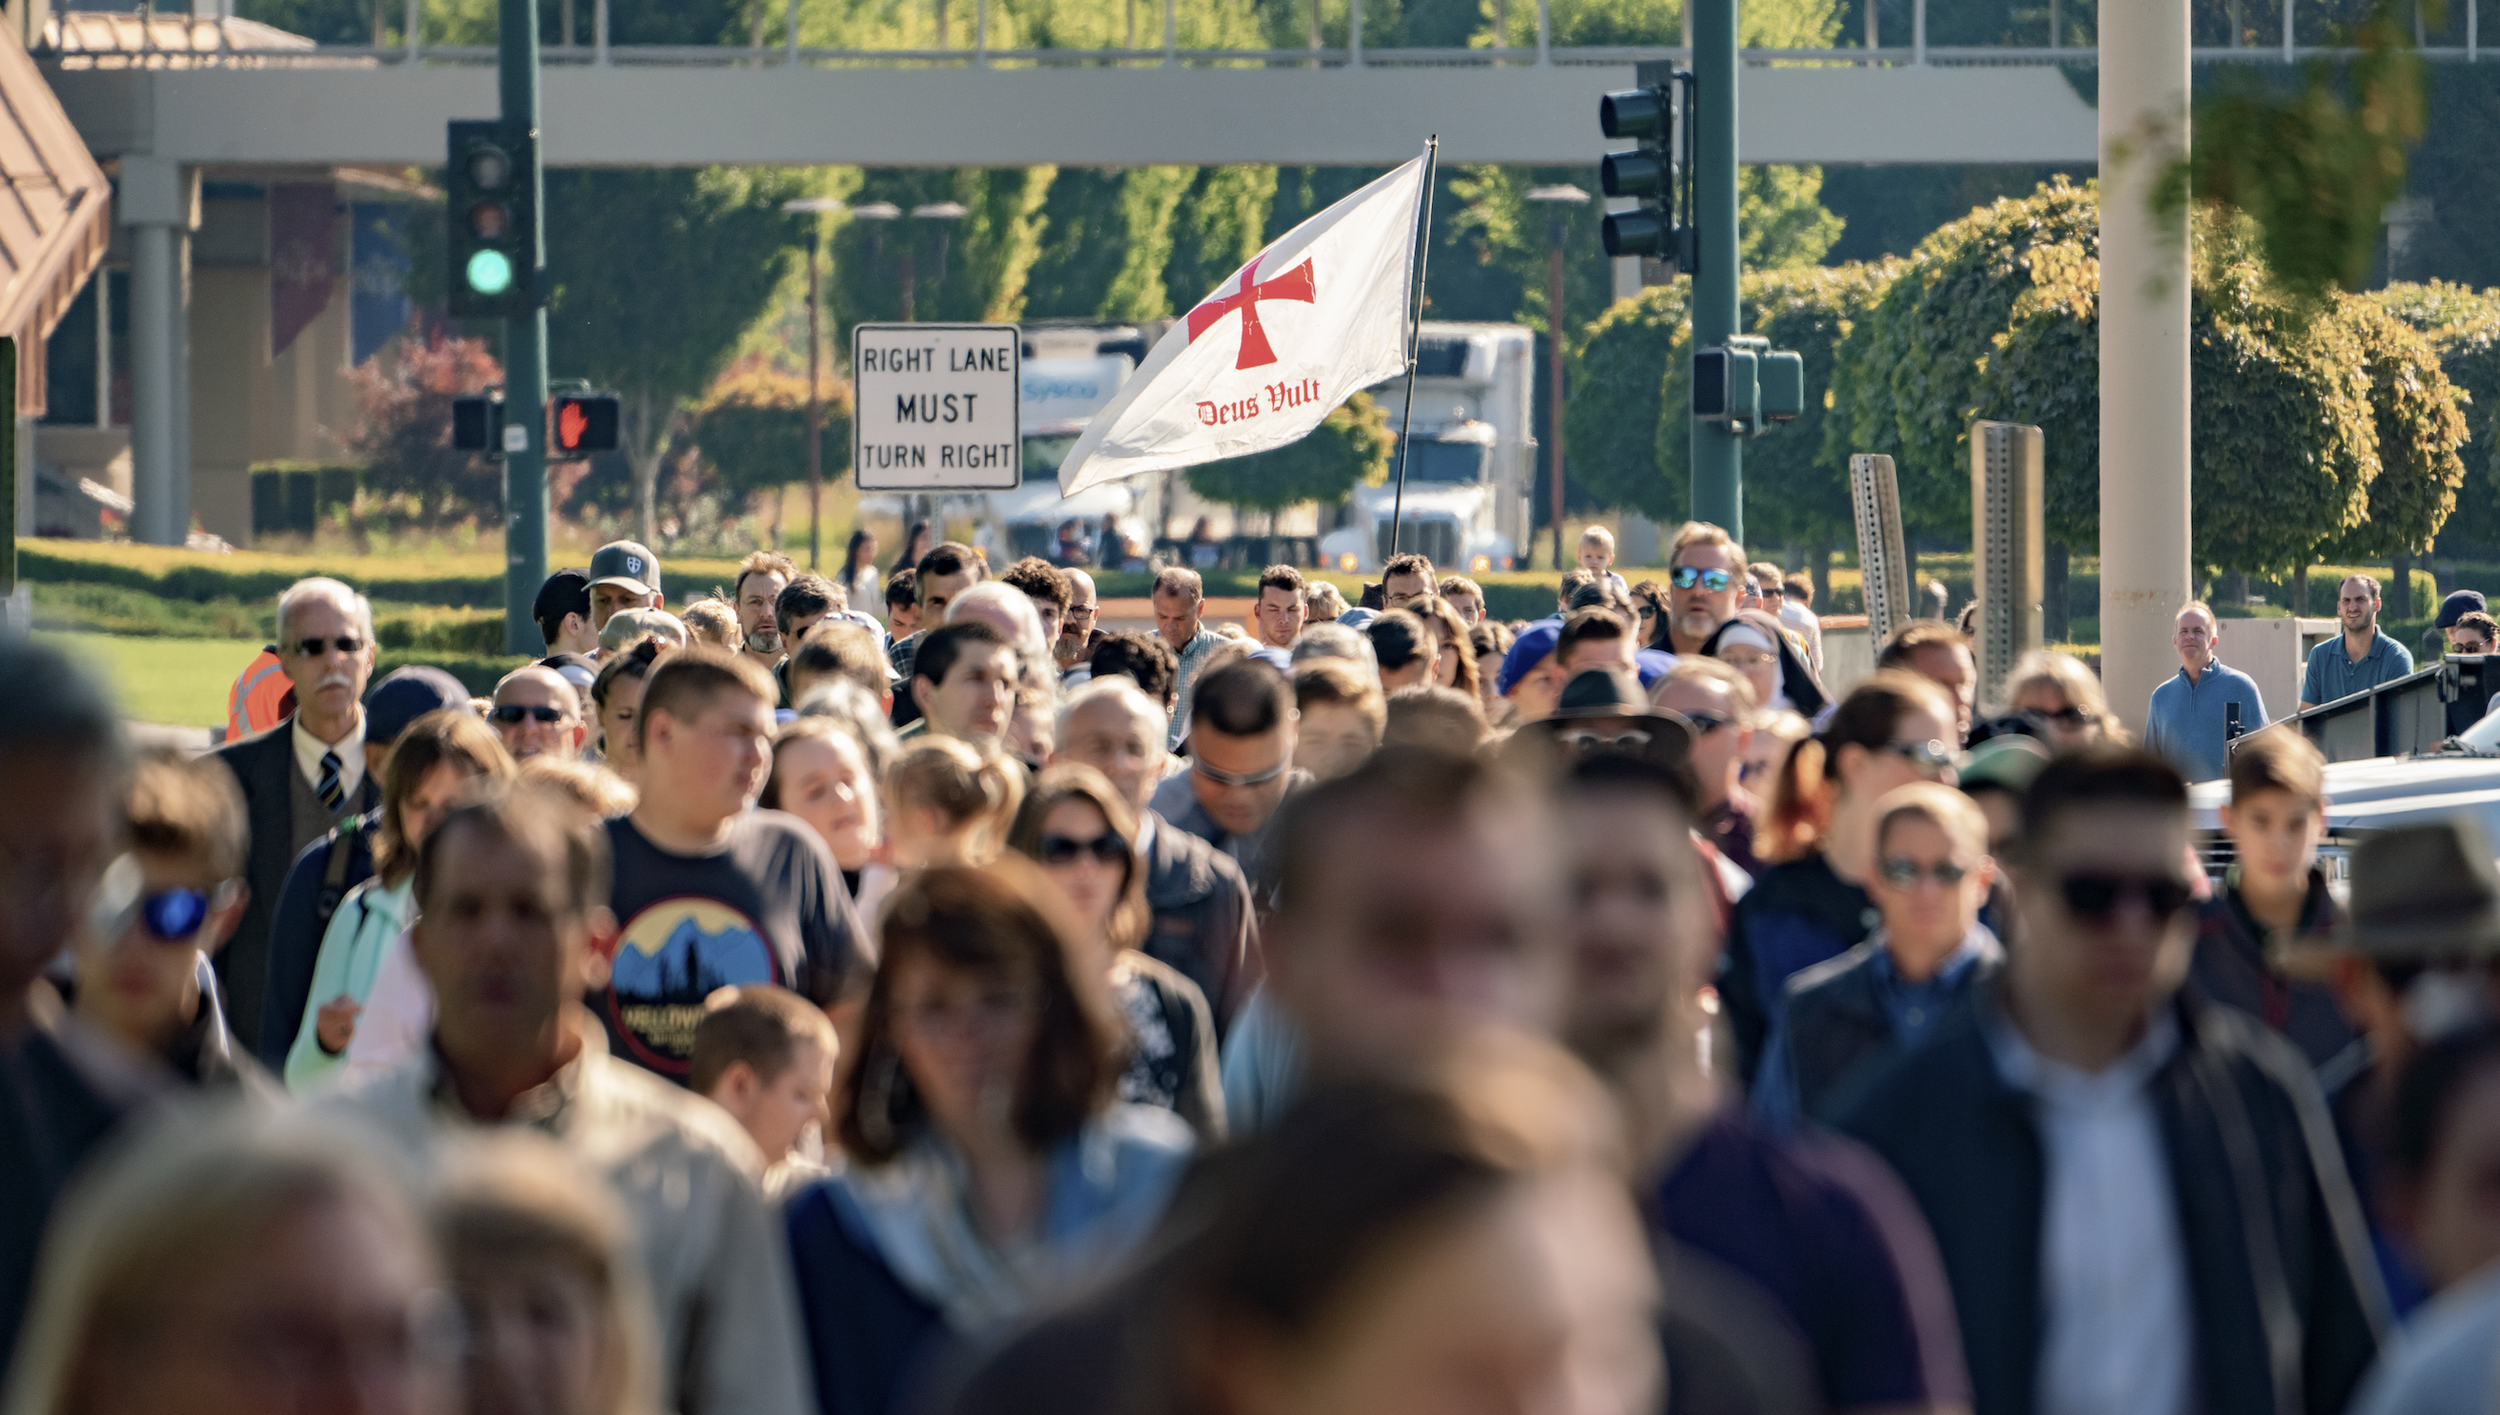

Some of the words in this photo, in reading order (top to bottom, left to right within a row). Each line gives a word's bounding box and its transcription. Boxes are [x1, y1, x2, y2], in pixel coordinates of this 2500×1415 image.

[864, 348, 935, 372] RIGHT
[950, 348, 1010, 372] LANE
[897, 394, 978, 423] MUST
[1195, 393, 1259, 426] Deus
[1264, 378, 1320, 412] Vult
[864, 445, 926, 468] TURN
[941, 444, 1012, 468] RIGHT
